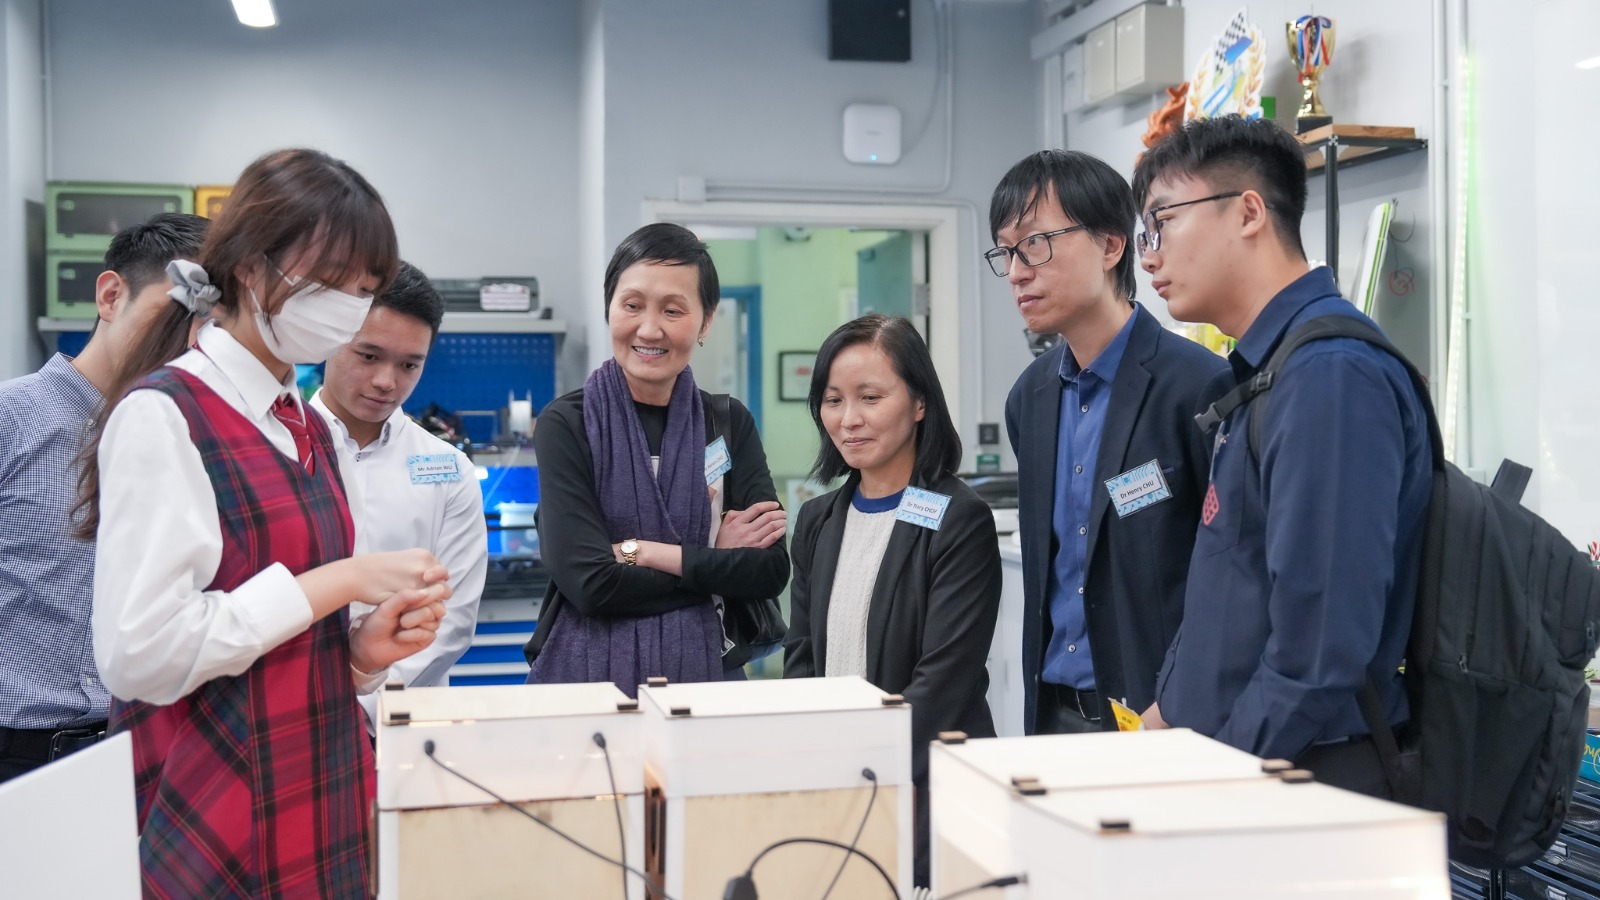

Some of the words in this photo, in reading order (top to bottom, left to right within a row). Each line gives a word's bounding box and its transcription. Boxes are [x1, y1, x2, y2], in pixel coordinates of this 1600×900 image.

[1127, 486, 1142, 495] Henry
[1143, 481, 1154, 489] CHU
[913, 503, 925, 512] Tracy
